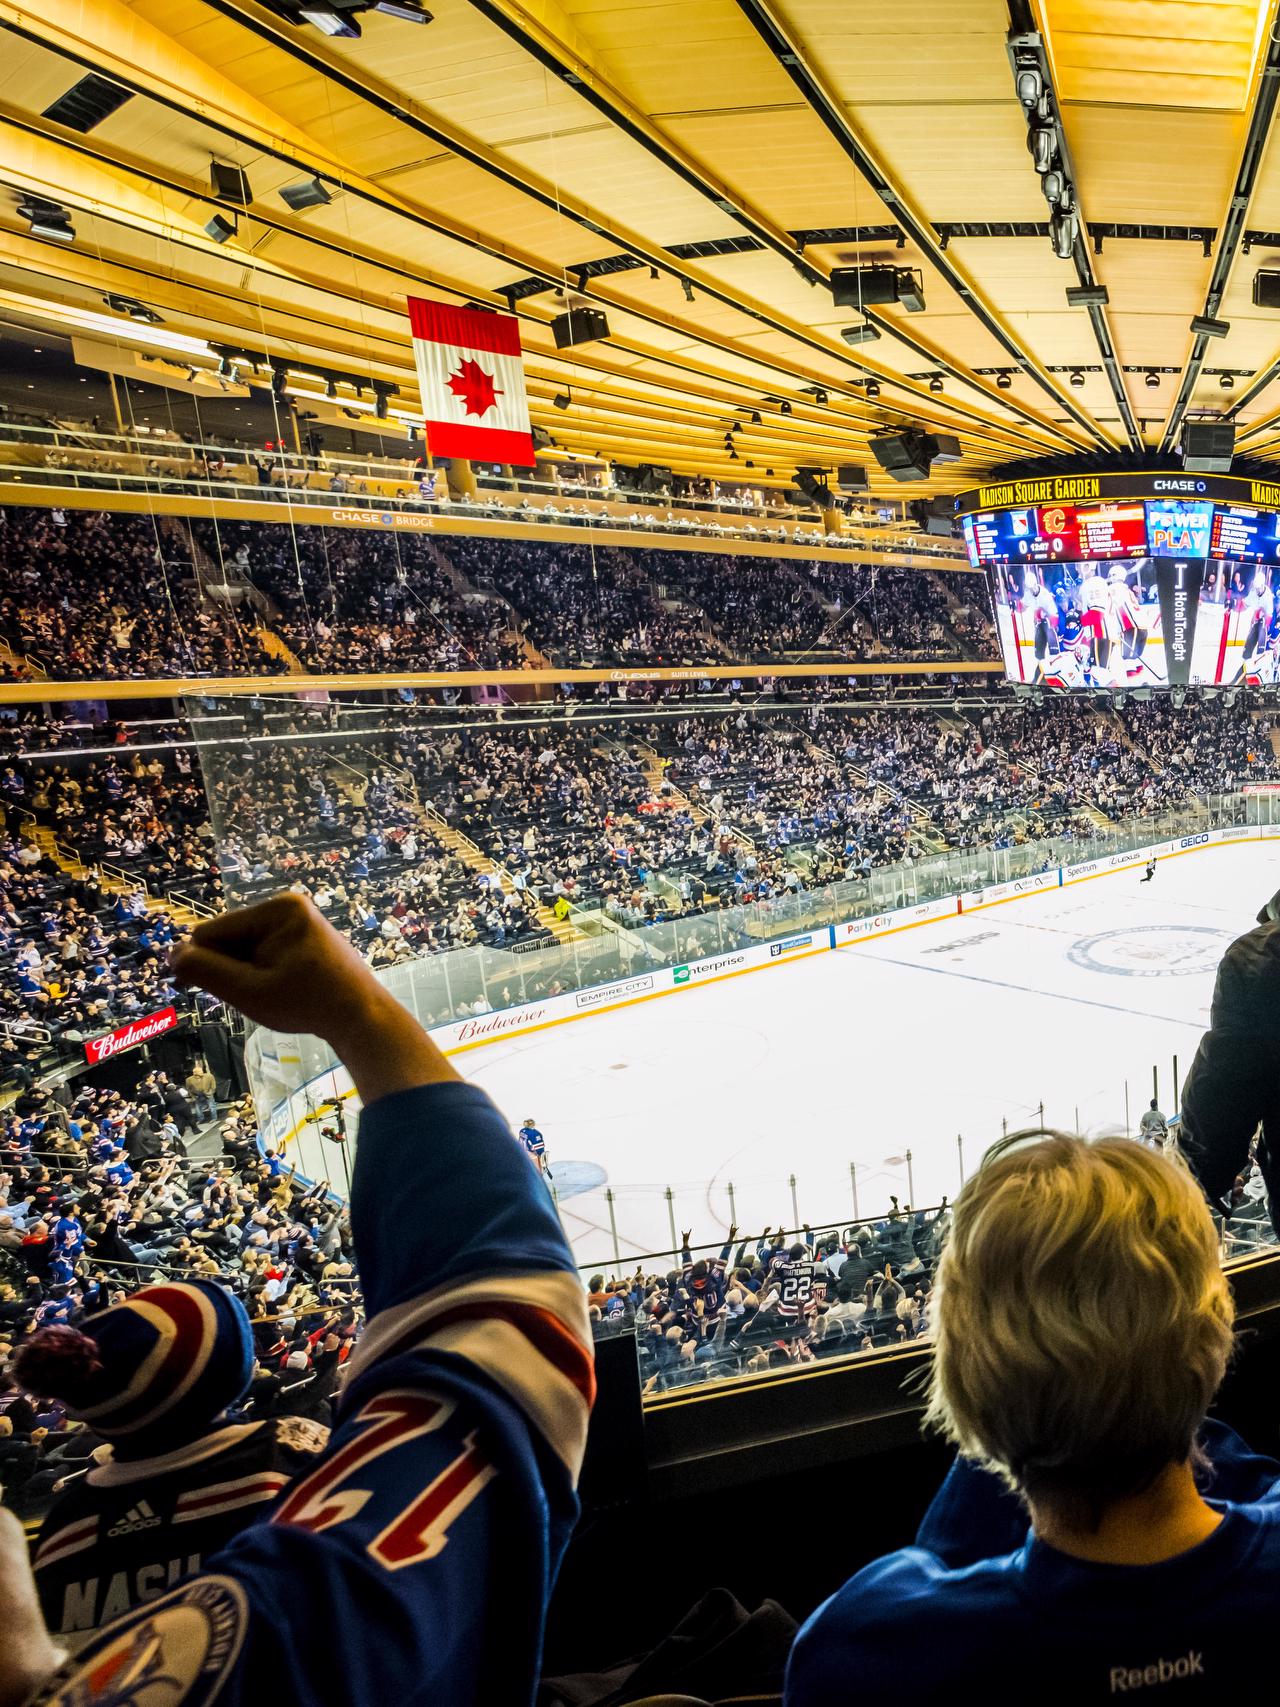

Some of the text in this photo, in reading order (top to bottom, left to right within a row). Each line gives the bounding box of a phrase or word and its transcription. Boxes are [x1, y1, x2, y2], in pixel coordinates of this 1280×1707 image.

[979, 479, 1100, 507] MADISON SQUARE GARDEN
[1154, 480, 1195, 491] CHASE
[332, 511, 435, 527] CHASE BRIDGE
[1019, 540, 1028, 554] 0
[1052, 537, 1063, 552] 0
[1154, 529, 1206, 549] PLAY
[1172, 591, 1187, 661] HotelTonight
[1181, 834, 1209, 848] GEICO
[1116, 852, 1141, 865] LEXUS
[1067, 863, 1097, 878] Spectrum
[848, 916, 893, 934] Party City
[580, 979, 649, 1003] EMPIRE CITY
[453, 1008, 548, 1041] Budweiser
[92, 1016, 172, 1060] Budweiser
[784, 1276, 811, 1302] 22
[107, 1515, 162, 1537] adidas
[1110, 1649, 1204, 1694] Reebok
